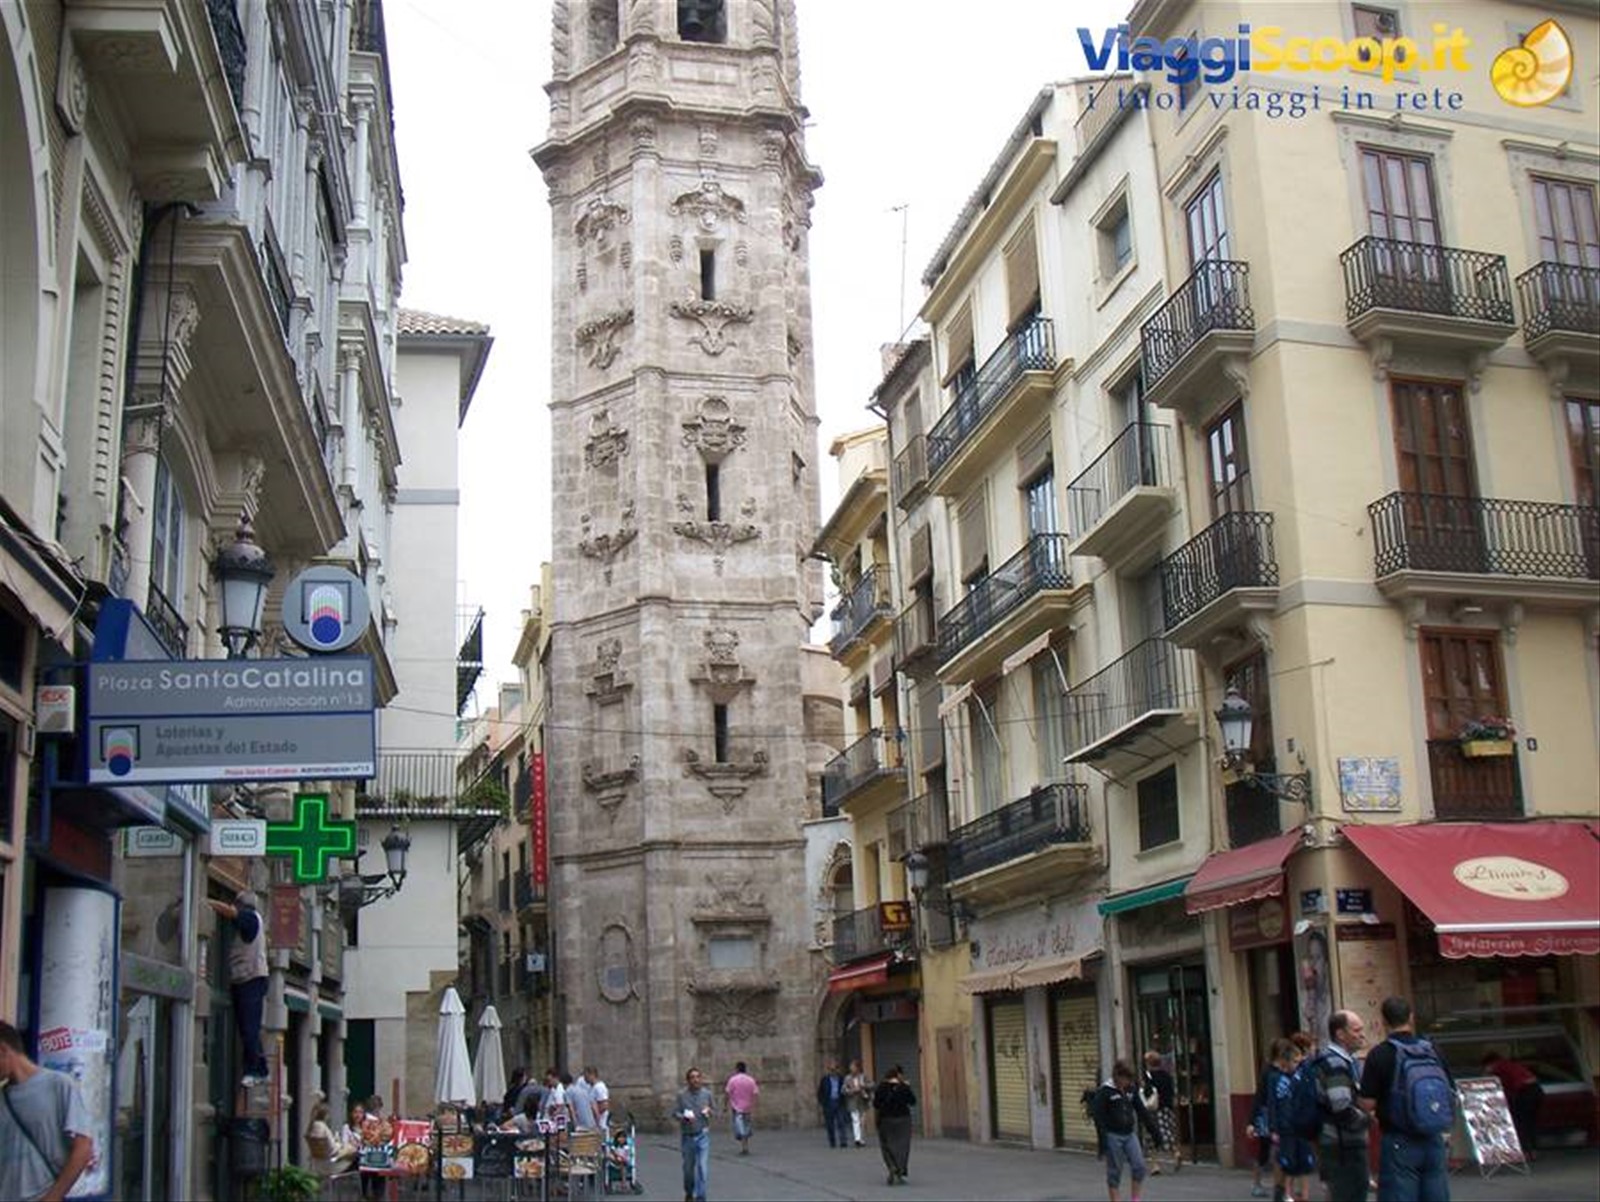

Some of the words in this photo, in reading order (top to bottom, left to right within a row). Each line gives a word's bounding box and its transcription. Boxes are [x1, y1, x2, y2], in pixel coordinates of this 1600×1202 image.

[99, 676, 153, 691] Plaza
[216, 727, 226, 741] y
[225, 739, 246, 755] del
[250, 738, 298, 754] Estado
